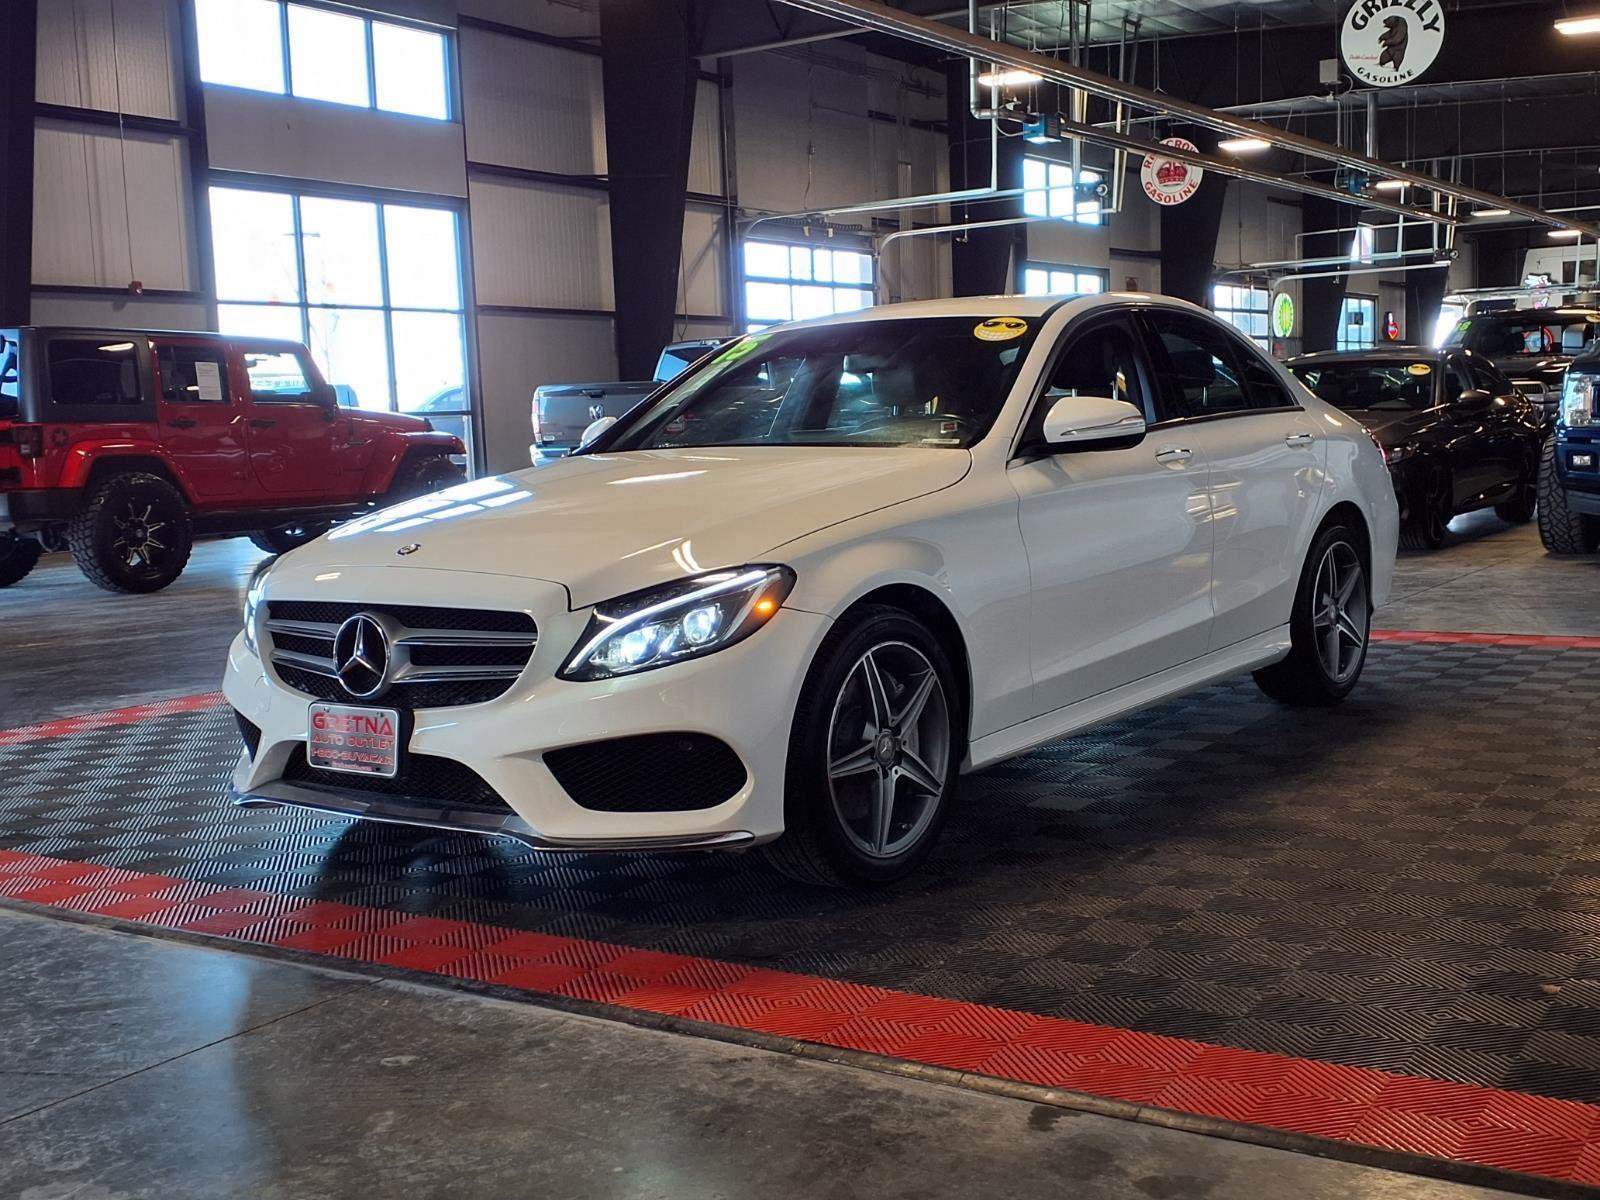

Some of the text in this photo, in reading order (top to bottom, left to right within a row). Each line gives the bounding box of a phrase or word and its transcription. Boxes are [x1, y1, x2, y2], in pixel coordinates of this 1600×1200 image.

[1357, 67, 1414, 83] GASOLINE
[1144, 179, 1199, 204] GASOLINE
[312, 712, 394, 737] GRETNA
